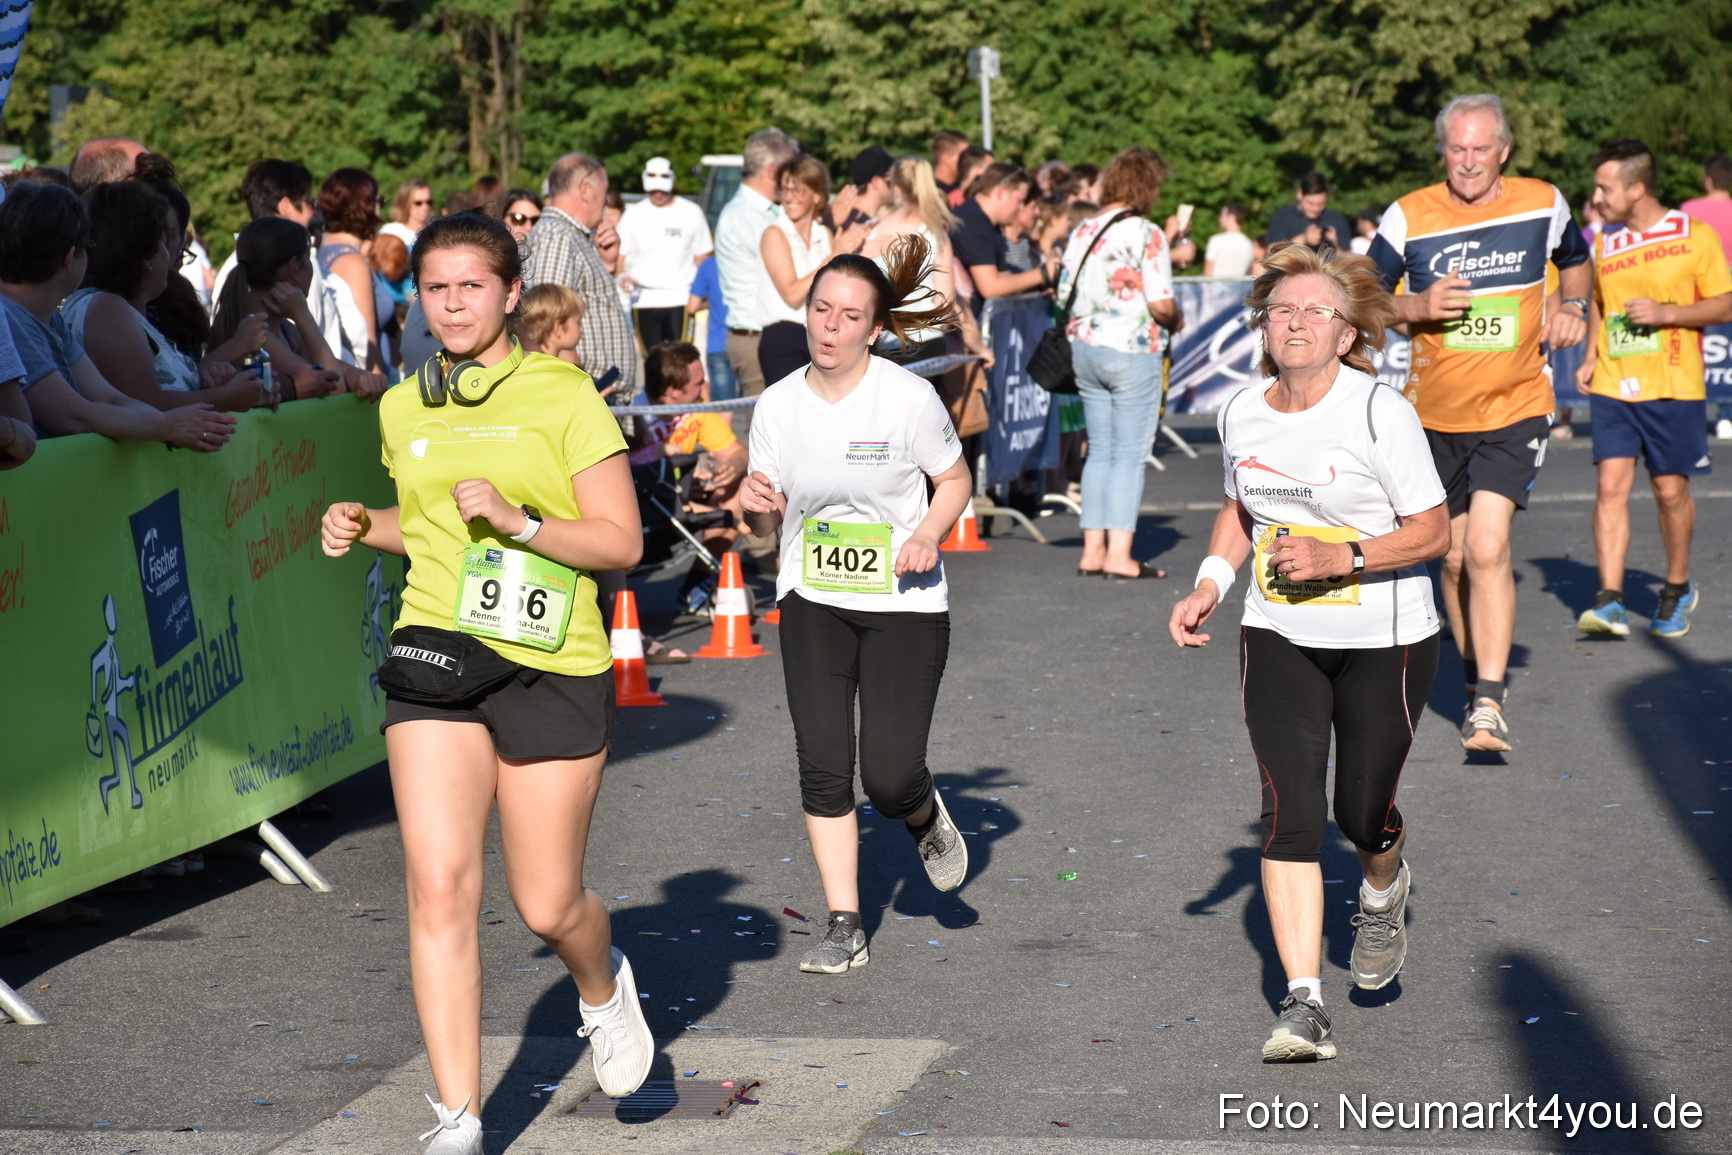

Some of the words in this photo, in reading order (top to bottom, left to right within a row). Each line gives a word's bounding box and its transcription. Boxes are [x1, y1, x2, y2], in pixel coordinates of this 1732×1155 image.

[1447, 250, 1527, 273] Fischer
[1458, 265, 1522, 279] AUTOMOBILE
[1601, 256, 1637, 276] MAX
[1644, 244, 1692, 262] BÖGL
[1461, 317, 1502, 336] 595
[272, 438, 315, 492] Firmen
[1244, 485, 1313, 499] Seniorenstift
[1246, 500, 1264, 510] am
[1303, 501, 1322, 512] Hof
[246, 514, 288, 583] laufen
[812, 545, 878, 573] 1402
[149, 545, 178, 584] Fischer
[820, 571, 843, 579] Körner
[156, 571, 180, 598] AUTOMOBILE
[1270, 582, 1303, 592] Handfest
[1304, 584, 1343, 593] Walburga
[470, 609, 501, 623] Renner
[134, 595, 243, 752] firmenlauf
[148, 729, 199, 793] neumarkt
